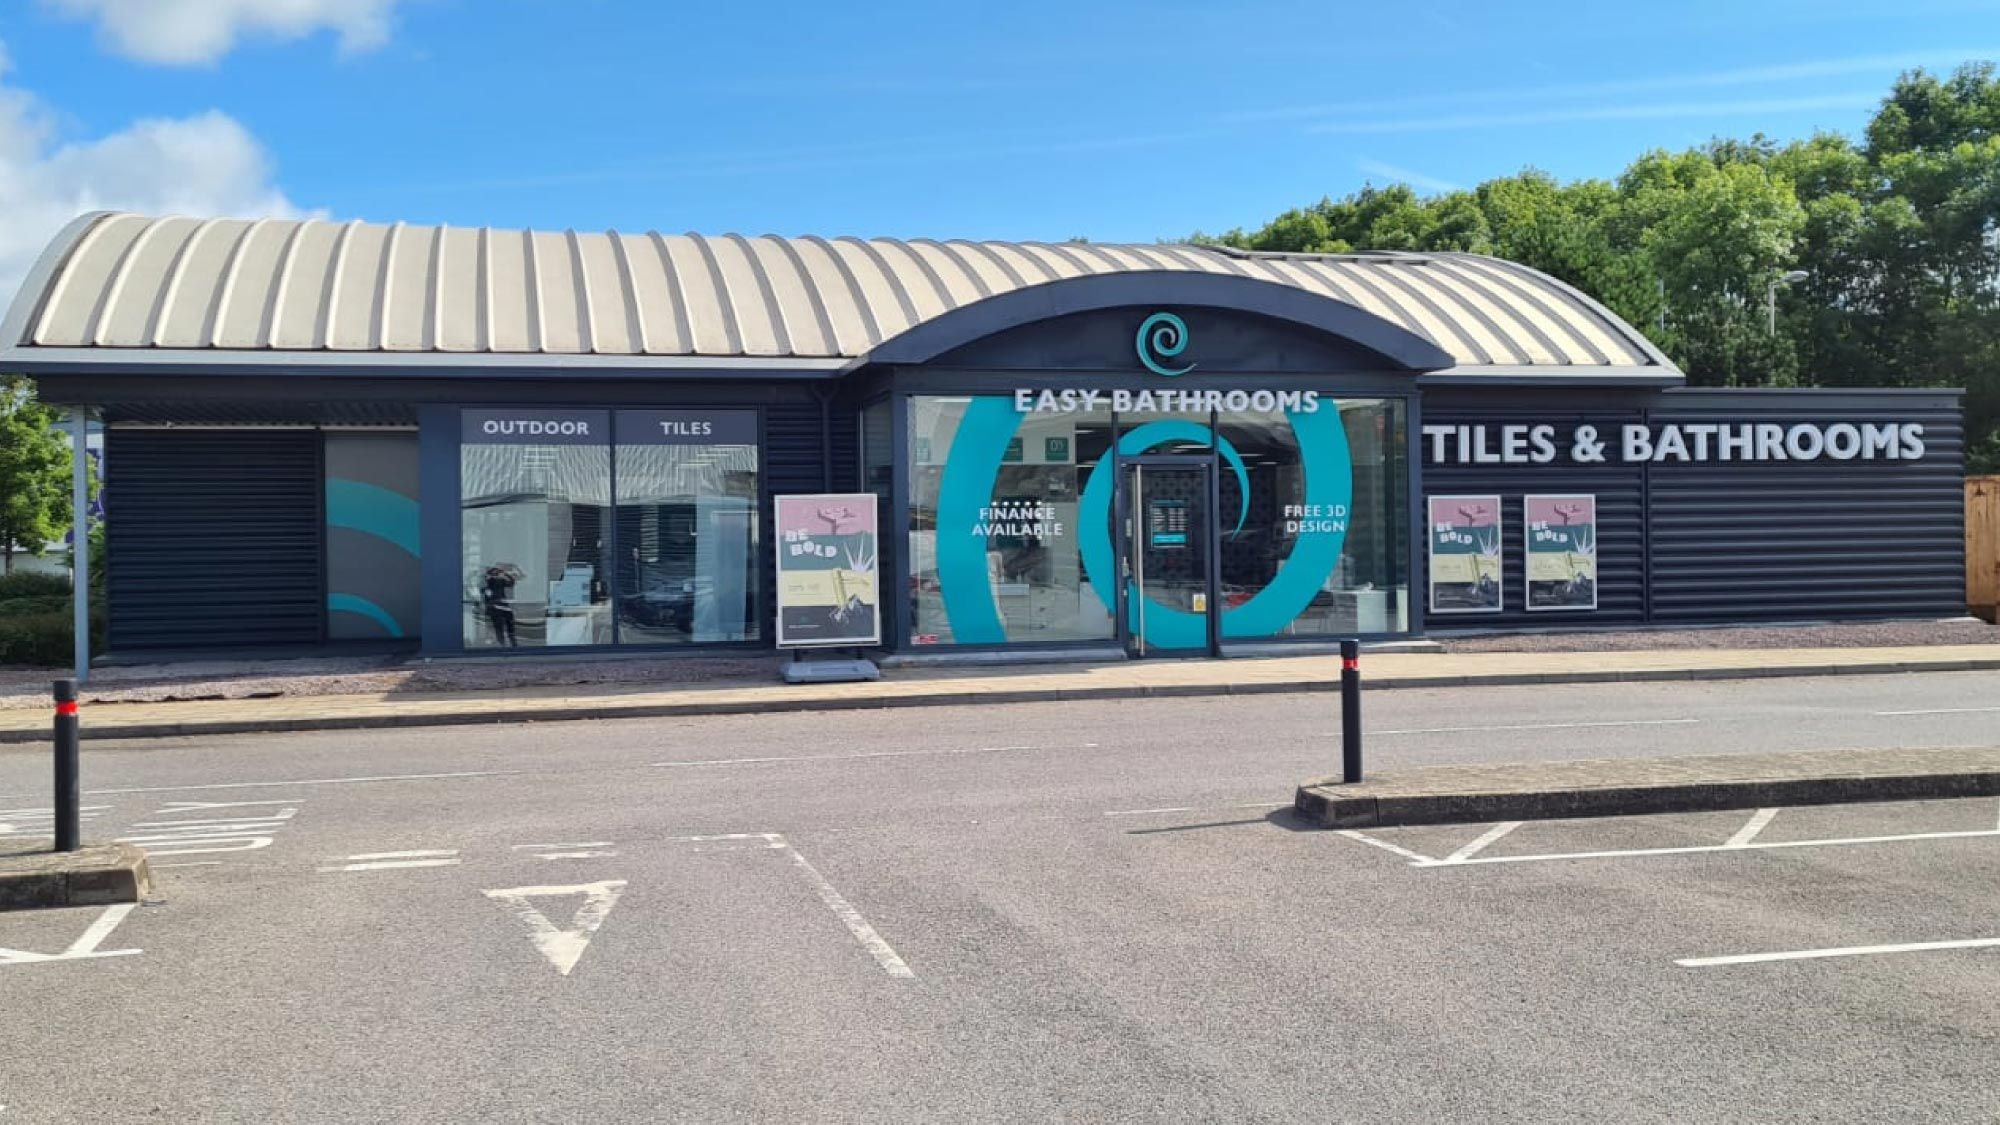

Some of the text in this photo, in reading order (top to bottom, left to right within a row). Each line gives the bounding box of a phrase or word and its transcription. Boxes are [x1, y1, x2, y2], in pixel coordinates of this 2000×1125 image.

[1015, 389, 1320, 413] EASY BATHROOMS
[483, 420, 589, 435] OUTDOOR
[660, 421, 712, 435] TILES
[1422, 423, 1926, 464] TILES & BATHROOMS
[979, 507, 1055, 519] FINANCE
[1284, 504, 1346, 517] FREE 3D
[972, 523, 1063, 535] AVAILABLE
[1286, 520, 1345, 533] DESIGN
[790, 541, 837, 557] BOLD
